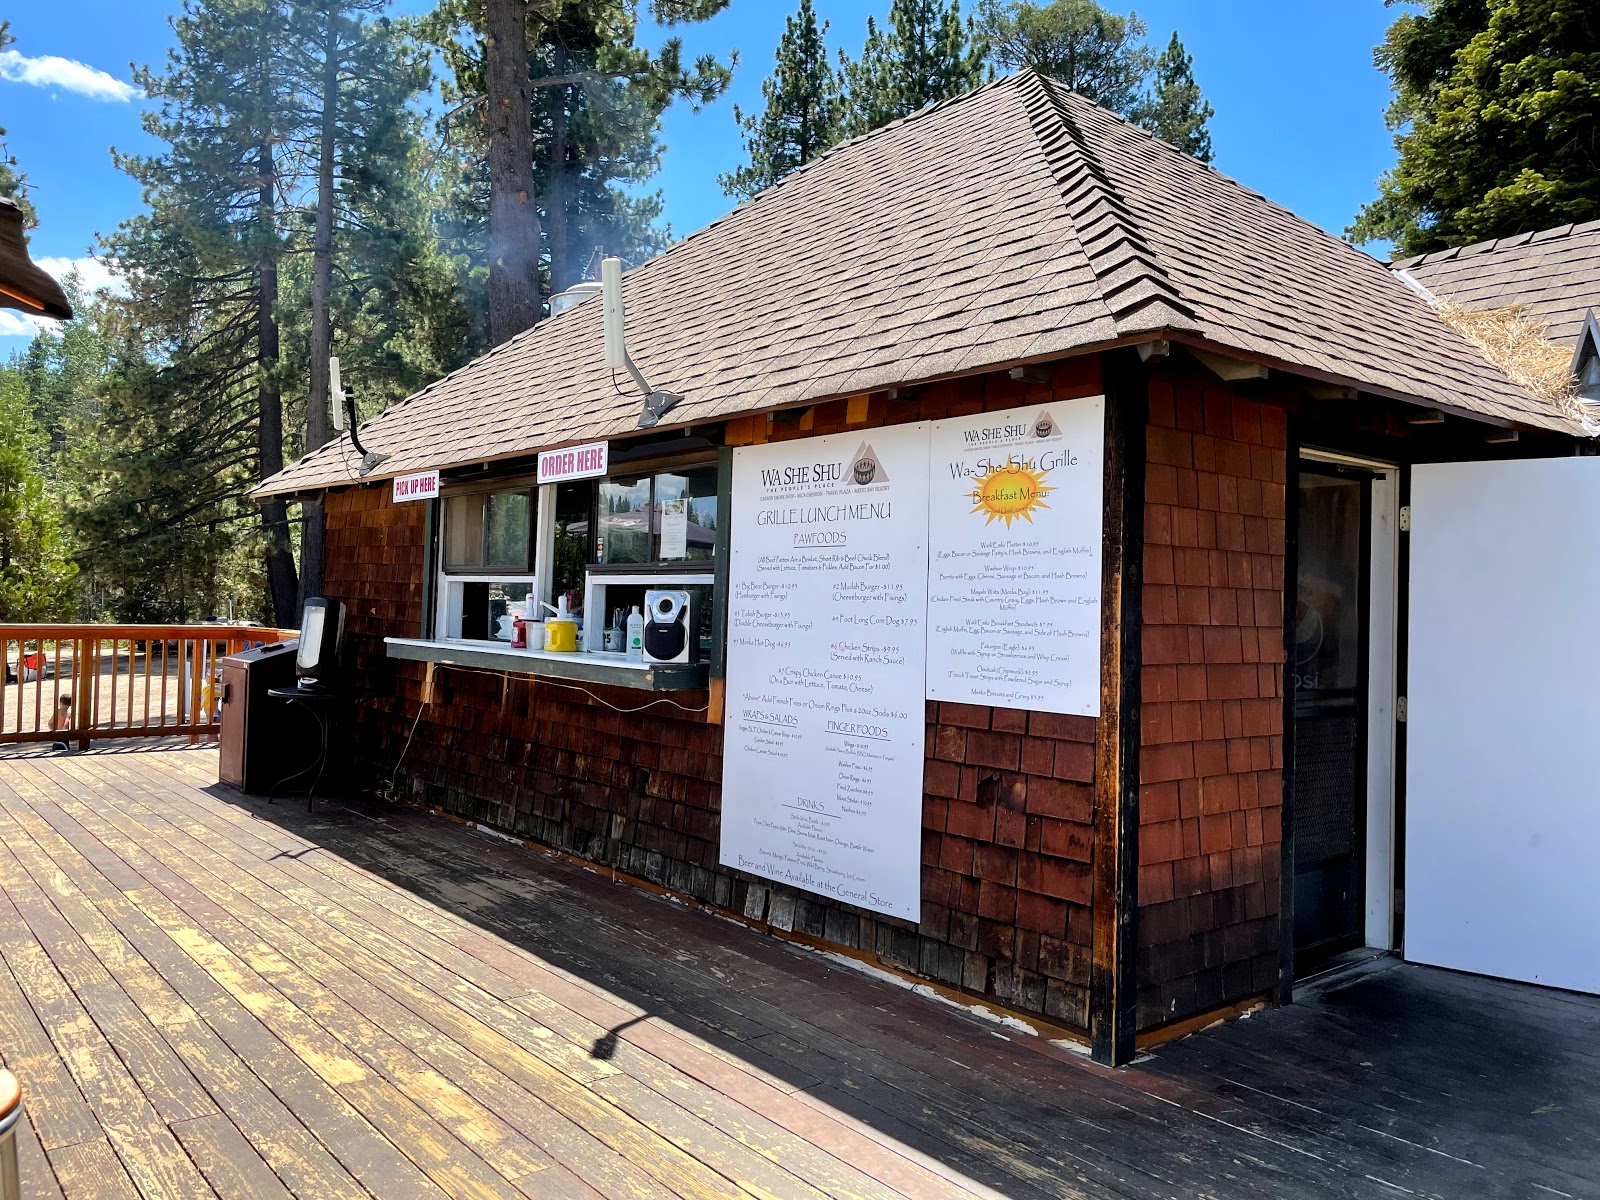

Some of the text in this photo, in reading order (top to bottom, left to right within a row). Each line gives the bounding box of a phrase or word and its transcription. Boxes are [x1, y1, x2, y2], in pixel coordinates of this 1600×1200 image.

[964, 424, 1026, 443] WA SHE SHU
[541, 447, 604, 478] ORDER HERE
[950, 449, 1078, 480] Wa-She-Shu Grille
[761, 462, 842, 487] WA SHE SHU
[395, 476, 436, 496] PICK UP HERE
[972, 487, 1050, 505] Breakfast Menu:
[757, 502, 891, 525] GRILLE LUNCH MENU
[818, 554, 831, 562] Short
[844, 553, 856, 562] Beef
[849, 562, 864, 570] Bacon
[865, 562, 874, 570] For
[1051, 571, 1065, 579] Hash
[741, 581, 750, 591] Big
[762, 581, 779, 591] Burger
[860, 581, 879, 592] Burger
[872, 592, 883, 600] with
[1077, 596, 1097, 605] English
[755, 609, 772, 620] Burger
[839, 613, 917, 627] Foot Long Dog $7.95
[1033, 628, 1046, 636] Side
[754, 638, 775, 649] Hot Dog
[838, 641, 860, 652] Chicken
[861, 642, 879, 655] Strips
[830, 651, 904, 665] (Served with Ranch Sauce)
[785, 666, 861, 682] Crispy Chicken Canoe $10.95
[1043, 677, 1052, 685] and
[804, 678, 825, 689] Lettuce,
[825, 680, 848, 691] Tomato,
[848, 682, 873, 694] Cheese)
[761, 694, 772, 703] Add
[772, 695, 789, 706] French
[808, 699, 825, 710] Onion
[825, 701, 840, 713] Rings
[841, 703, 852, 713] Plus
[858, 707, 871, 715] 20oz
[871, 706, 889, 718] Soda
[742, 708, 764, 720] WRAPS
[768, 712, 798, 725] SALADS
[827, 720, 888, 737] FINGER FOODS
[797, 796, 824, 812] DRINKS
[738, 853, 753, 870] Beer
[754, 858, 766, 872] and
[766, 861, 783, 878] Wine
[784, 867, 815, 888] Available
[816, 879, 823, 889] at
[824, 878, 835, 892] the
[836, 882, 867, 904] General
[868, 891, 893, 911] Store
